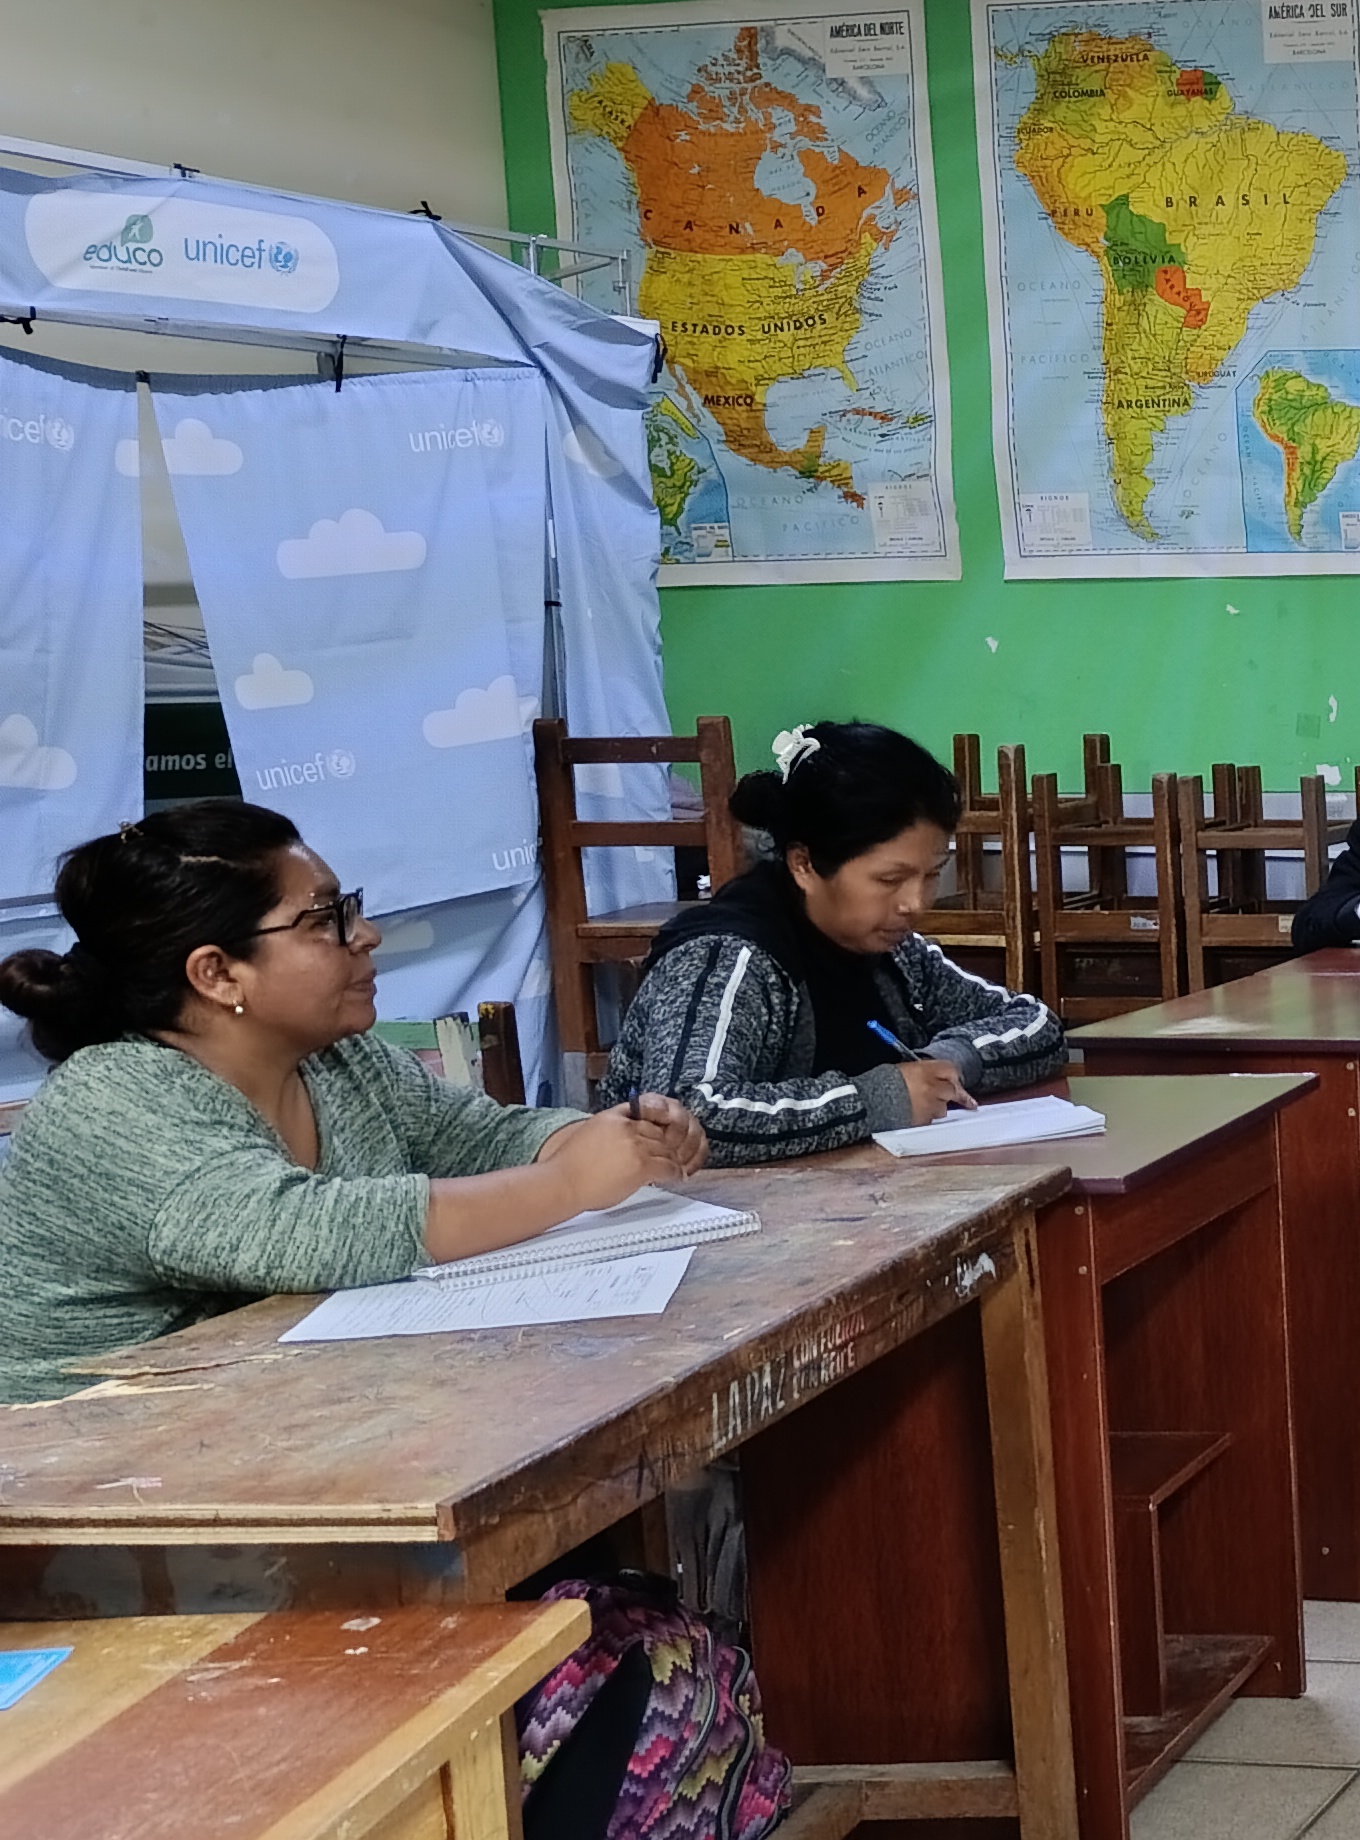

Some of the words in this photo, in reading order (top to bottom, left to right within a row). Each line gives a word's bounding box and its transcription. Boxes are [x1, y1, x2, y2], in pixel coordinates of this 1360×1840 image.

[1269, 2, 1305, 19] AMÉRICA
[1331, 3, 1348, 17] SUR
[880, 21, 905, 35] NORTE
[1081, 53, 1150, 63] VENEZUELA
[1053, 89, 1106, 99] COLOMBIA
[1167, 87, 1214, 97] GUAYANAS
[1165, 193, 1291, 208] BRASIL
[643, 185, 867, 235] CANADA
[1051, 208, 1094, 218] PERU
[83, 241, 164, 268] educo
[184, 234, 266, 269] unicef
[1113, 255, 1177, 266] BOLIVIA
[671, 321, 745, 336] ESTADOS
[761, 313, 827, 334] UNIDOS
[703, 394, 754, 407] MEXICO
[1116, 398, 1191, 410] ARGENTINA
[409, 419, 480, 452] unicef
[256, 752, 326, 791] unicef
